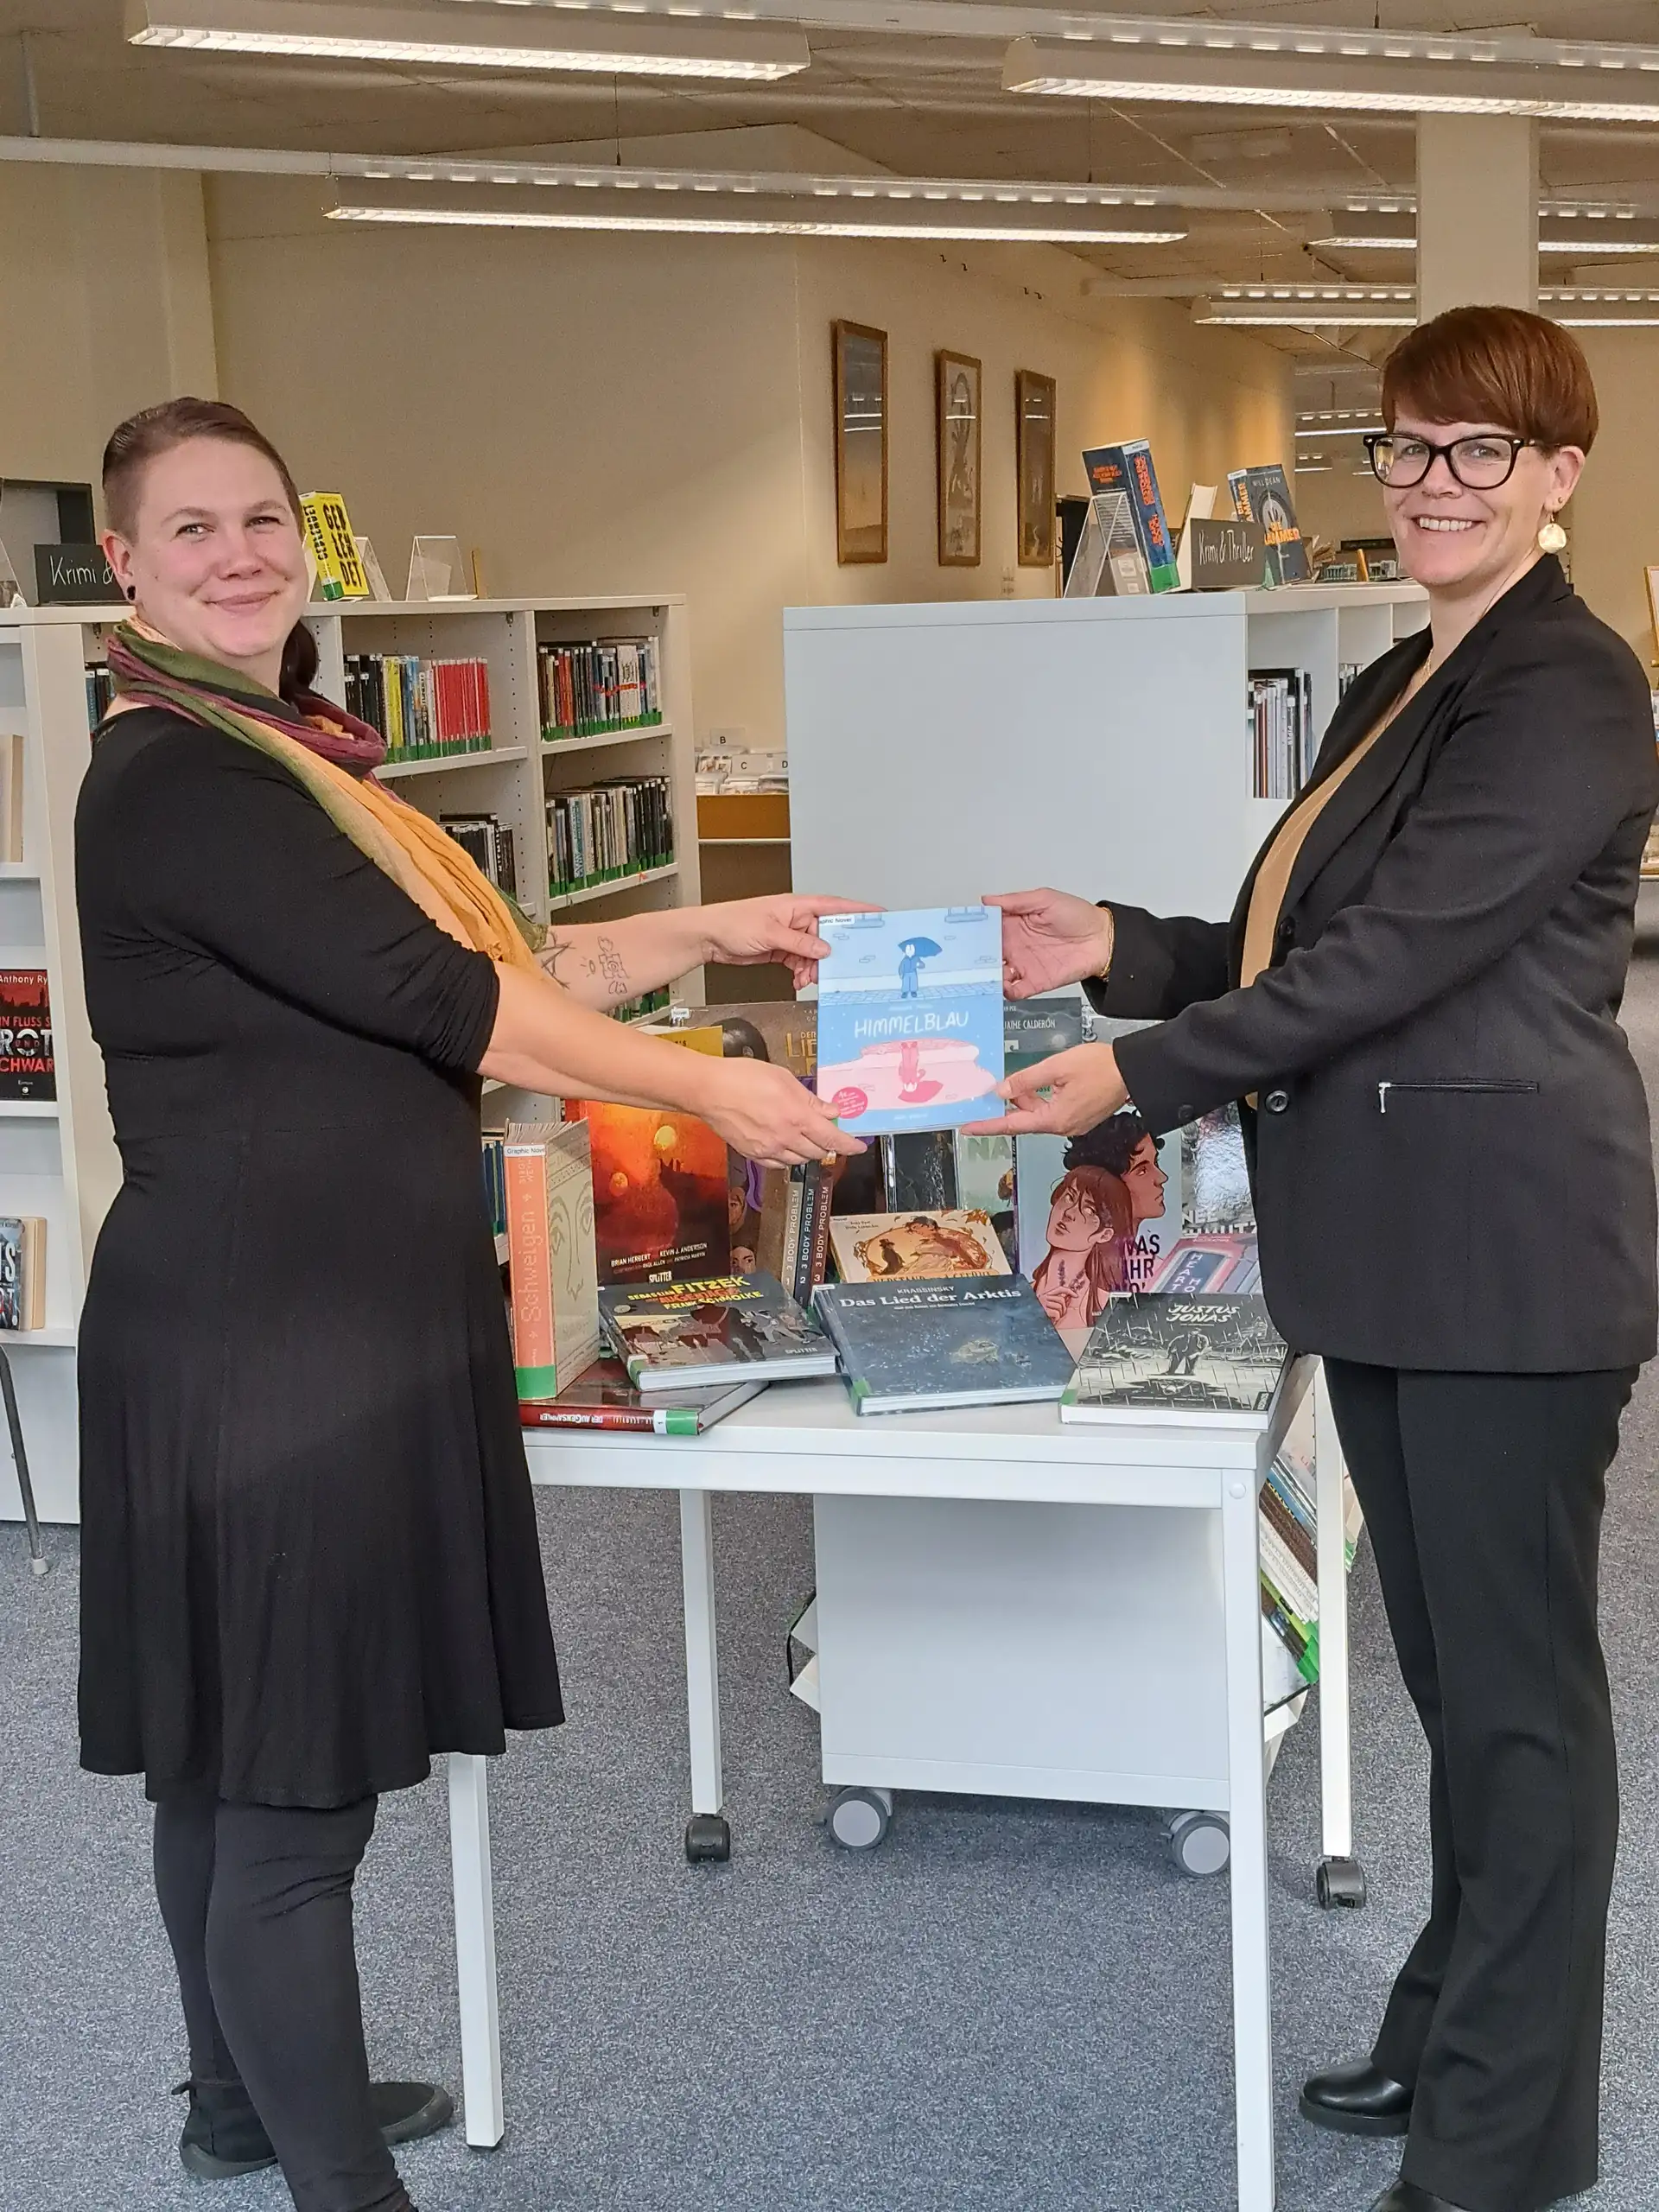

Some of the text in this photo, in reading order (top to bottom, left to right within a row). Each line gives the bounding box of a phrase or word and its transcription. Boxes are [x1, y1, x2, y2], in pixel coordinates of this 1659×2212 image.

[1198, 529, 1218, 565] Krimi
[1219, 531, 1227, 564] &
[1227, 529, 1255, 563] Thriller
[50, 555, 114, 586] Krimi &
[741, 761, 747, 770] C
[0, 975, 34, 985] Anthony
[13, 1016, 41, 1027] FLUSS
[855, 1010, 969, 1039] HIMMELBLAU
[1023, 1017, 1056, 1030] CALDERÓN
[0, 1028, 53, 1057] ROT
[790, 1190, 799, 1234] PROBLEM
[804, 1188, 814, 1233] PROBLEM
[818, 1186, 829, 1230] PROBLEM
[611, 1258, 627, 1268] BRIAN
[627, 1253, 652, 1263] HERBERT
[659, 1248, 675, 1257] KEVIN
[680, 1243, 708, 1253] ANDERSON
[802, 1236, 810, 1262] BODY
[518, 1211, 542, 1323] Schweigen
[814, 1274, 821, 1282] 3
[627, 1276, 752, 1300] SEBASTIAN FITZEK
[839, 1298, 876, 1308] Das
[880, 1294, 921, 1306] Lied
[927, 1293, 957, 1303] der
[963, 1289, 1022, 1301] Arktis
[897, 1285, 955, 1294] KRASSINSKY
[664, 1291, 765, 1310] FRANK SCHMOLKE
[1168, 1303, 1240, 1314] JUSTUS
[1166, 1313, 1231, 1323] JONAS
